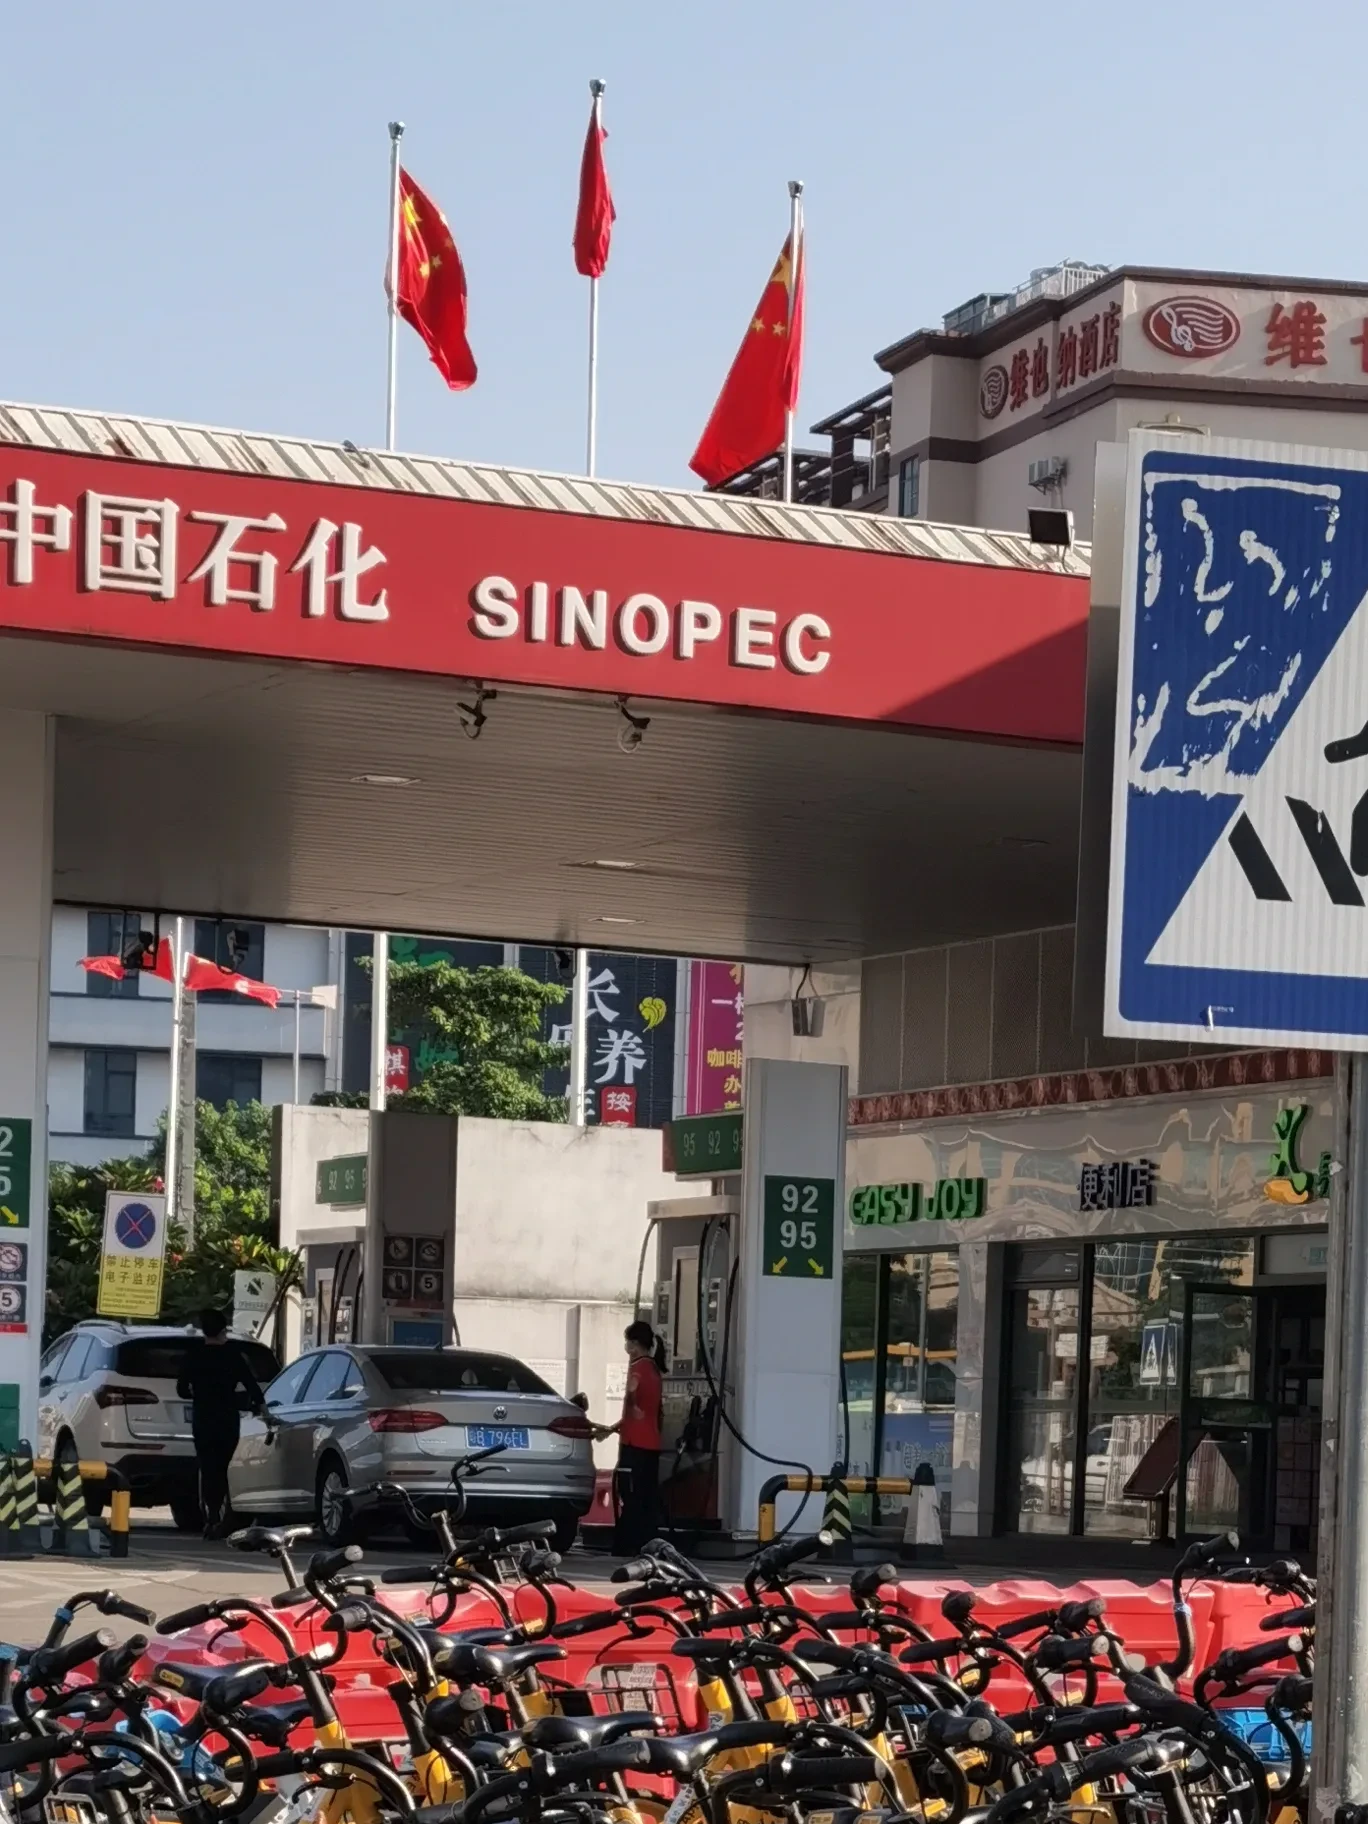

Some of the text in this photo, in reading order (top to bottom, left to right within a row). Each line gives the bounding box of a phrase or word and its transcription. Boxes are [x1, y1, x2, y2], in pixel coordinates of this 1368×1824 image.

[0, 478, 389, 622] 中国石化
[472, 575, 832, 674] SINOPEC
[708, 1130, 721, 1155] 92
[781, 1184, 819, 1214] 92
[1080, 1159, 1157, 1211] 便利店
[849, 1177, 987, 1225] EASY JOY
[780, 1219, 818, 1250] 95
[106, 1255, 160, 1271] 禁止停车
[105, 1271, 158, 1286] 电子监控
[424, 1277, 433, 1290] 5
